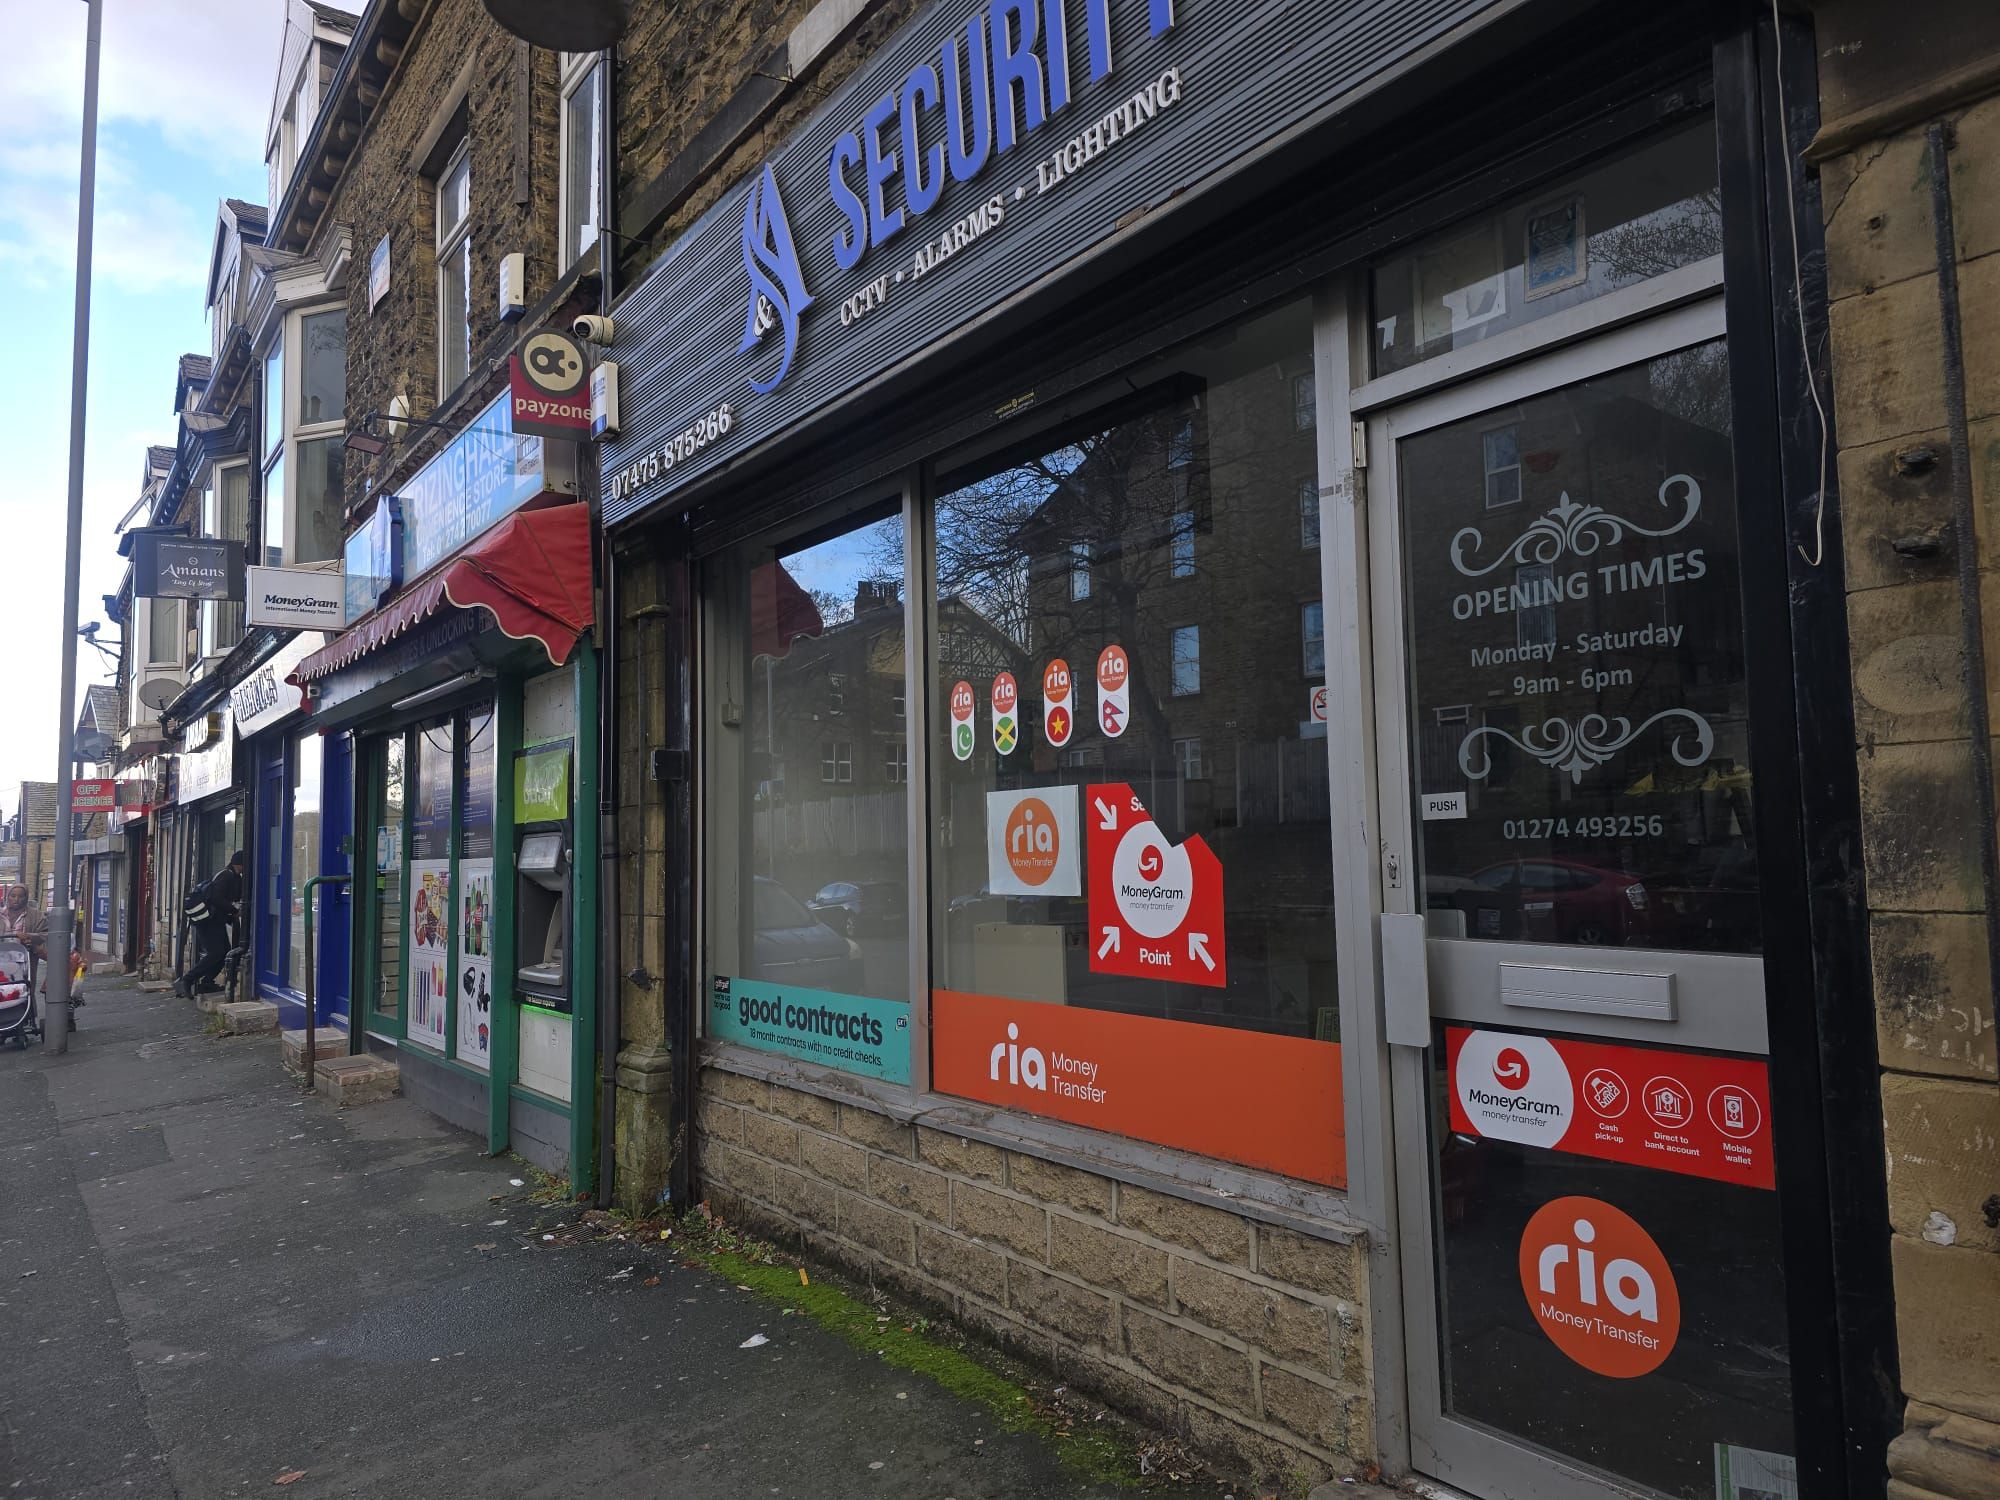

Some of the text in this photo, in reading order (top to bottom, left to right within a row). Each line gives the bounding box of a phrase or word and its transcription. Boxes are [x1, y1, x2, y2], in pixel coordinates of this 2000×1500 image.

[829, 0, 1175, 270] SECURI
[839, 66, 1184, 328] CCTV ALARMS LIGHTING
[515, 397, 592, 420] payzone
[612, 403, 733, 501] 07475 875266
[474, 461, 508, 504] STORE
[160, 563, 225, 578] Amaans
[1452, 549, 1707, 621] OPENING TIMES
[264, 594, 338, 609] MoneyGram
[426, 610, 474, 649] UNLOCKING
[1471, 635, 1557, 667] Monday
[1576, 622, 1684, 655] Saturday
[1100, 651, 1125, 675] ria
[994, 677, 1014, 700] ria
[1046, 665, 1068, 689] ria
[1513, 675, 1559, 696] 9am
[1581, 665, 1633, 692] 6pm
[953, 686, 971, 708] ria
[76, 784, 101, 796] OFF
[1429, 799, 1458, 812] PUSH
[1012, 808, 1053, 853] ria
[1503, 815, 1663, 840] 01274 493256
[1012, 857, 1053, 869] Money Transfer
[1121, 884, 1183, 901] MoneyGram
[1129, 902, 1174, 912] money transfer
[1139, 947, 1172, 967] Point
[739, 995, 883, 1046] good contracts
[756, 1030, 776, 1043] month
[776, 1034, 807, 1050] contracts
[807, 1040, 823, 1053] with
[823, 1045, 832, 1055] no
[833, 1045, 854, 1060] credit
[854, 1049, 883, 1066] checks.
[990, 1022, 1046, 1091] ria
[1052, 1051, 1098, 1082] Money
[1052, 1075, 1107, 1104] Transfer
[1468, 1088, 1561, 1117] MoneyGram
[1481, 1110, 1547, 1127] money transfer
[1599, 1122, 1619, 1133] Cash
[1594, 1131, 1624, 1144] pick-up
[1644, 1140, 1700, 1157] bank account
[1653, 1131, 1689, 1145] Direct to
[1722, 1142, 1753, 1155] Mobile
[1724, 1154, 1752, 1166] wallet
[1538, 1218, 1659, 1324] ria
[1540, 1302, 1660, 1351] Money Transfer
